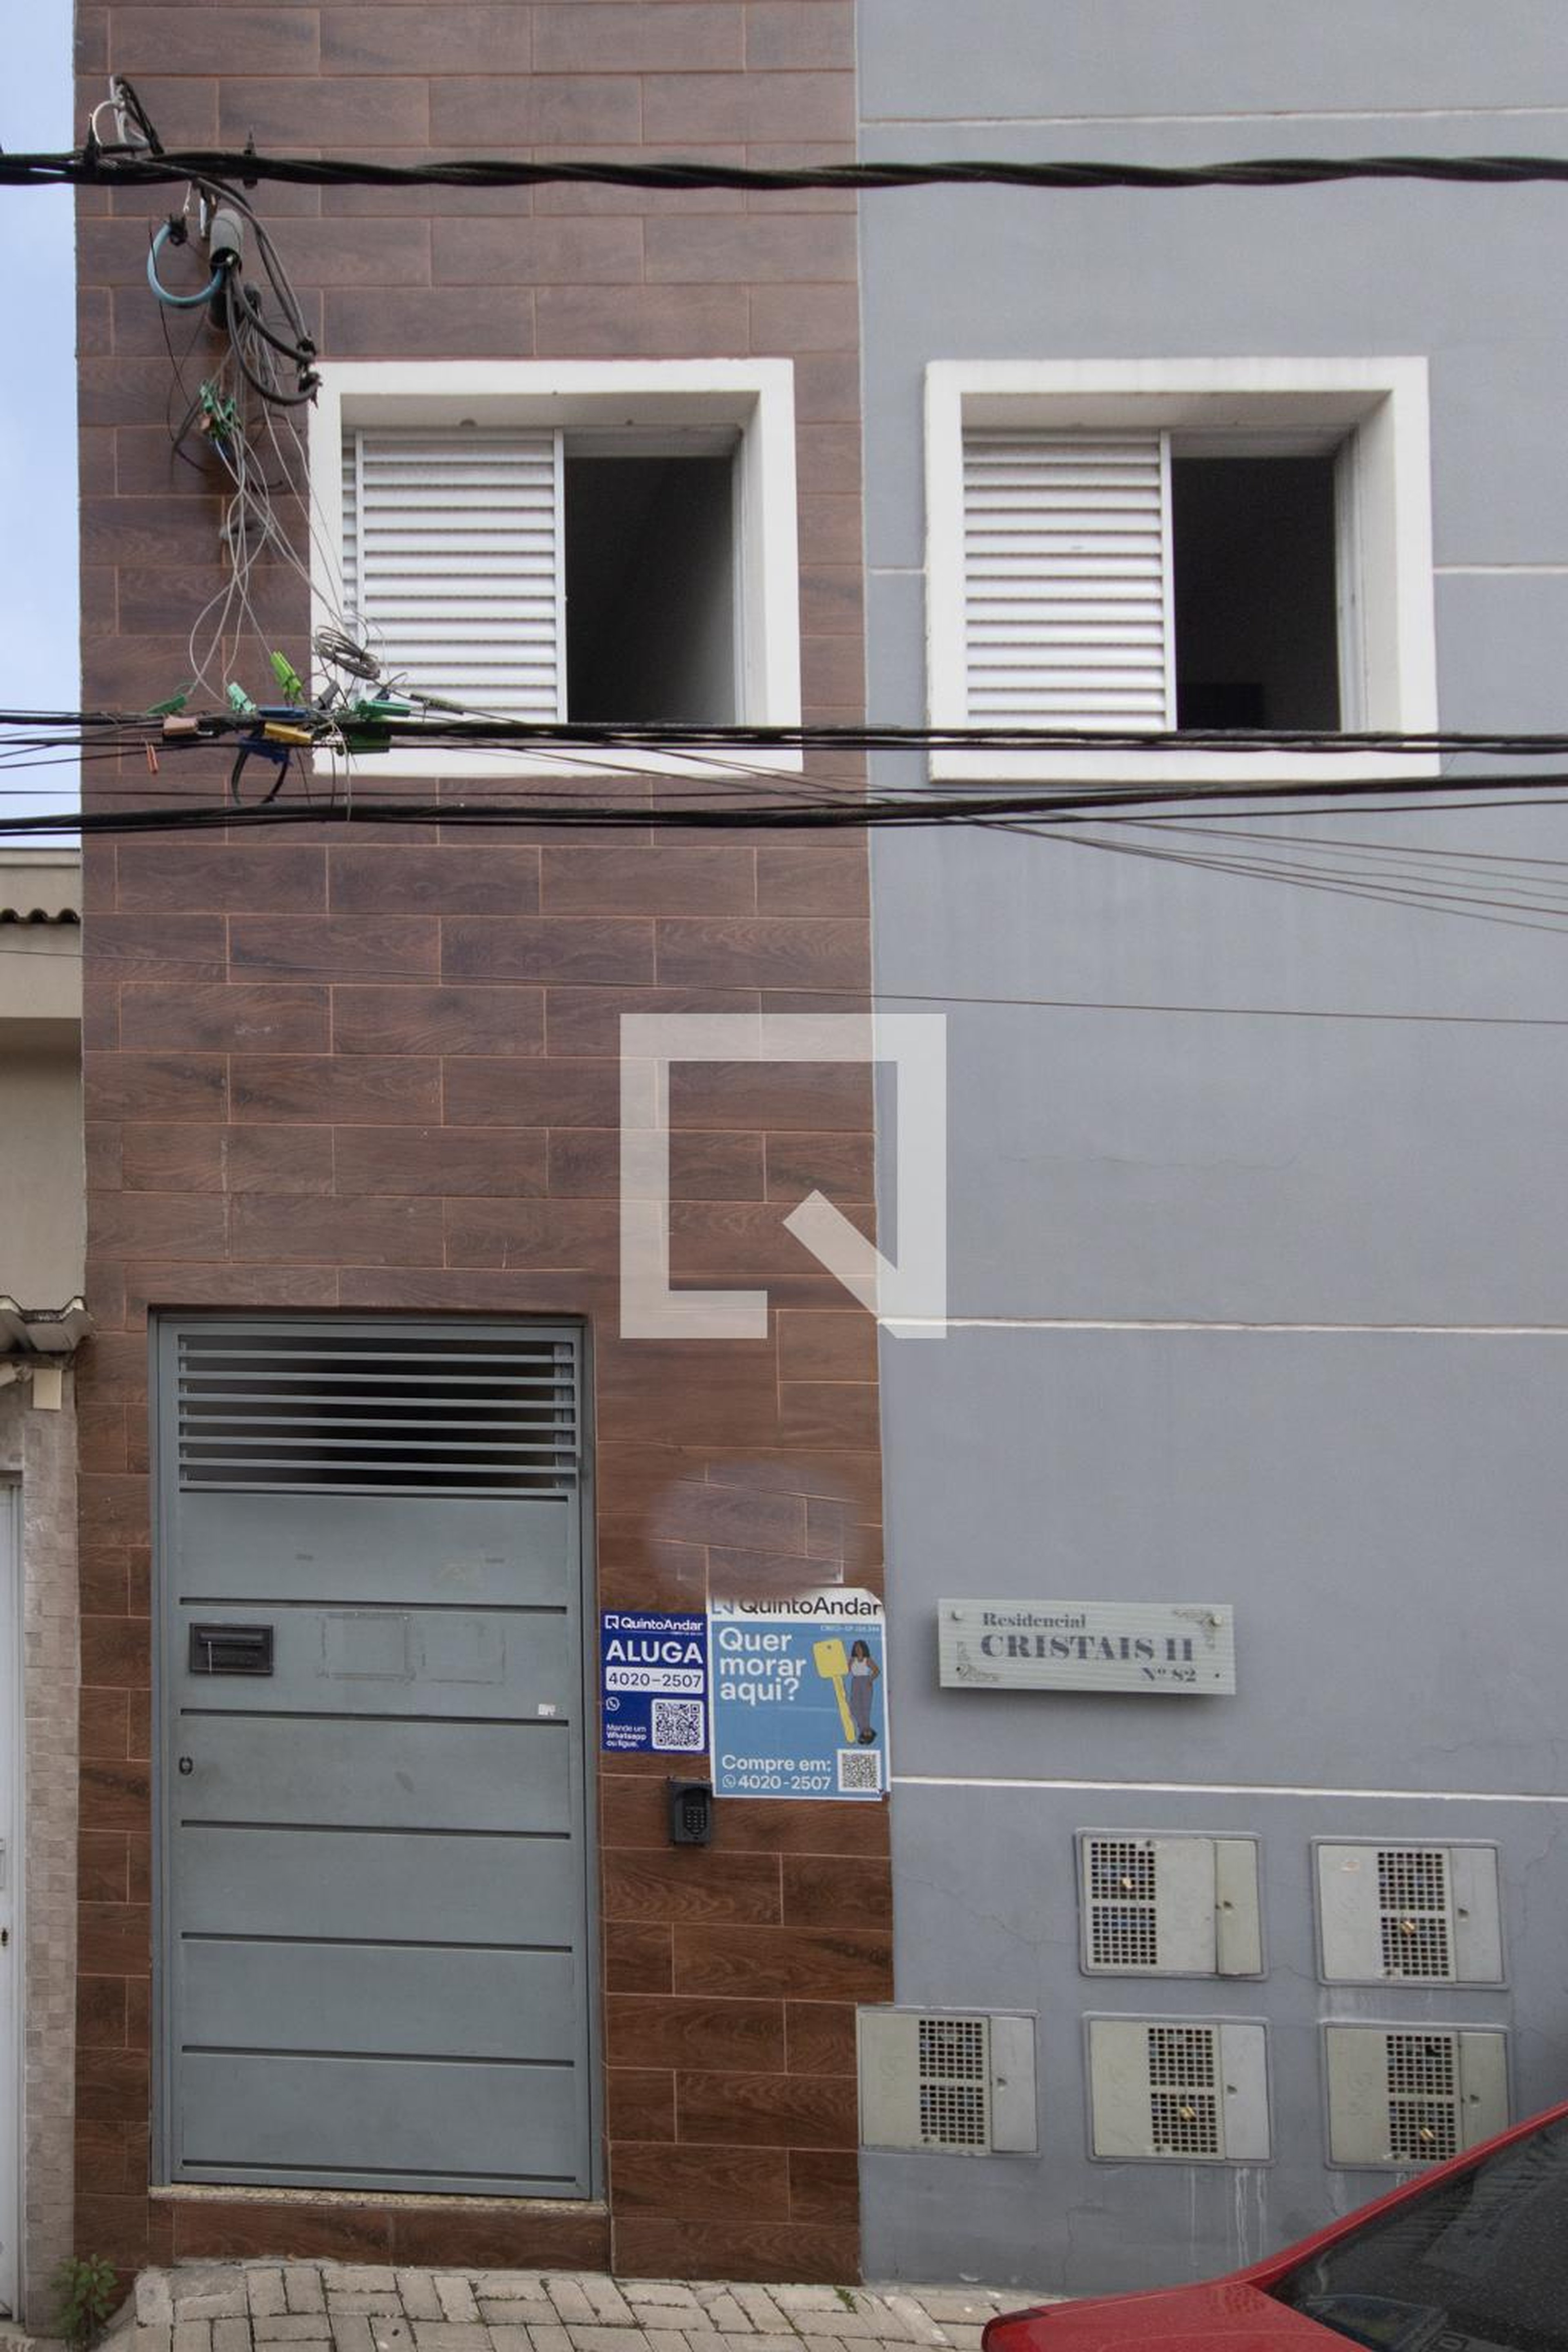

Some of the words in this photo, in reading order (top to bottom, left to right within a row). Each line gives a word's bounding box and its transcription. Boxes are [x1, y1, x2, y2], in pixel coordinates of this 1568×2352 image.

[739, 1597, 882, 1615] QuintoAndar
[621, 1617, 703, 1631] QuintoAndar
[982, 1613, 1086, 1628] Residencial
[719, 1627, 792, 1651] Quer
[981, 1634, 1154, 1661] CRISTAIS
[1167, 1638, 1193, 1662] II
[606, 1639, 703, 1664] ALUGA
[720, 1657, 807, 1676] morar
[609, 1672, 702, 1688] 4020-2507
[720, 1677, 799, 1706] aqui?
[722, 1755, 795, 1774] Compre
[799, 1758, 832, 1772] em:
[738, 1775, 832, 1790] 4020-2507
